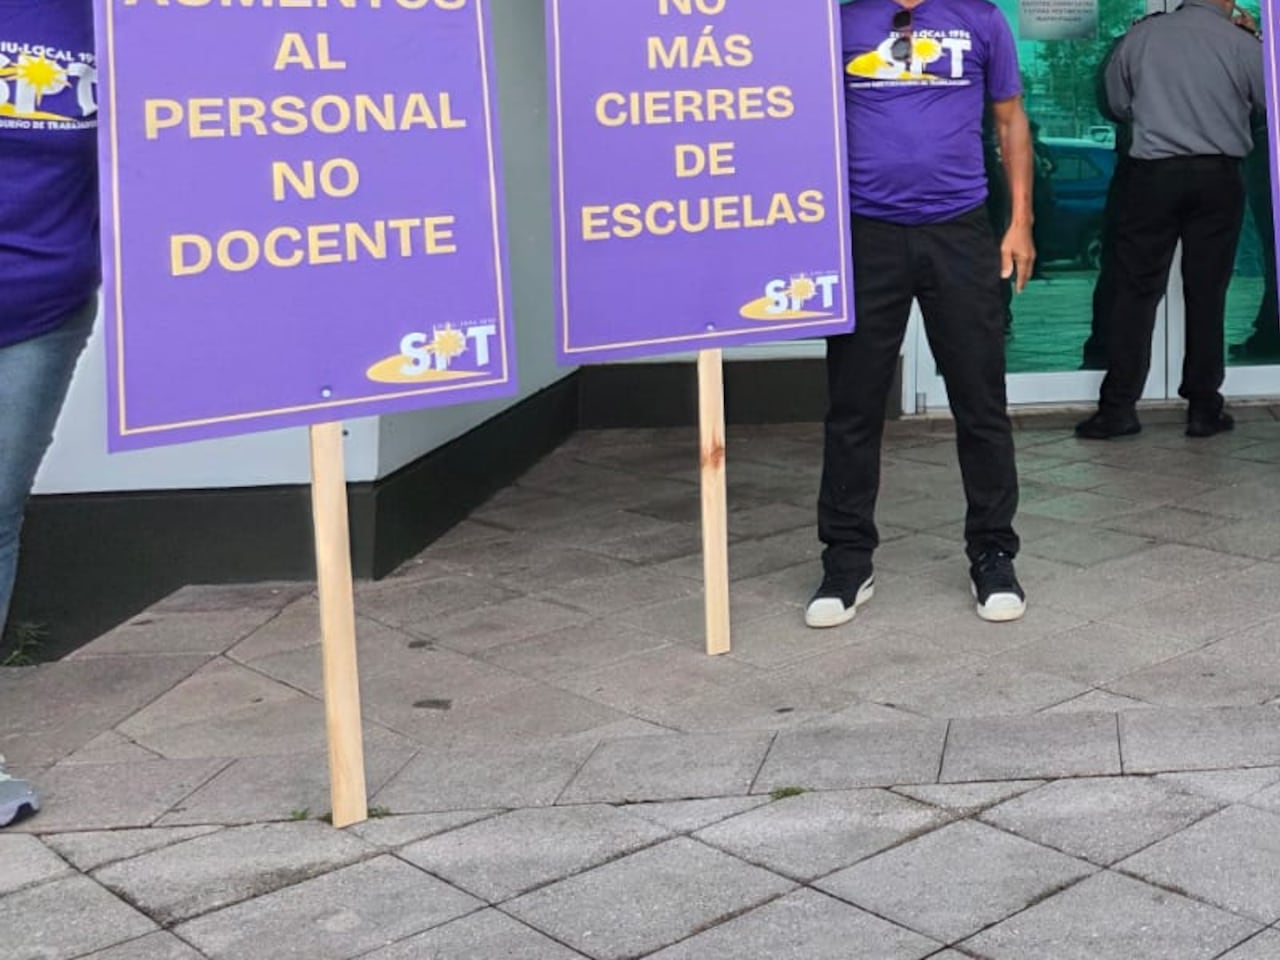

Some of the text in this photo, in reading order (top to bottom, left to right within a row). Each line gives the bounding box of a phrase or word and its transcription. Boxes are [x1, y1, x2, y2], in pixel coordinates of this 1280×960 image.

[274, 32, 346, 70] AL
[647, 24, 754, 68] MÁS
[0, 53, 98, 117] PT
[595, 85, 795, 126] CIERRES
[145, 92, 466, 139] PERSONAL
[272, 158, 360, 200] NO
[674, 142, 736, 178] DE
[581, 189, 826, 241] ESCUELAS
[170, 216, 457, 276] DOCENTE
[765, 274, 840, 313] SPT
[400, 325, 497, 375] SPT
